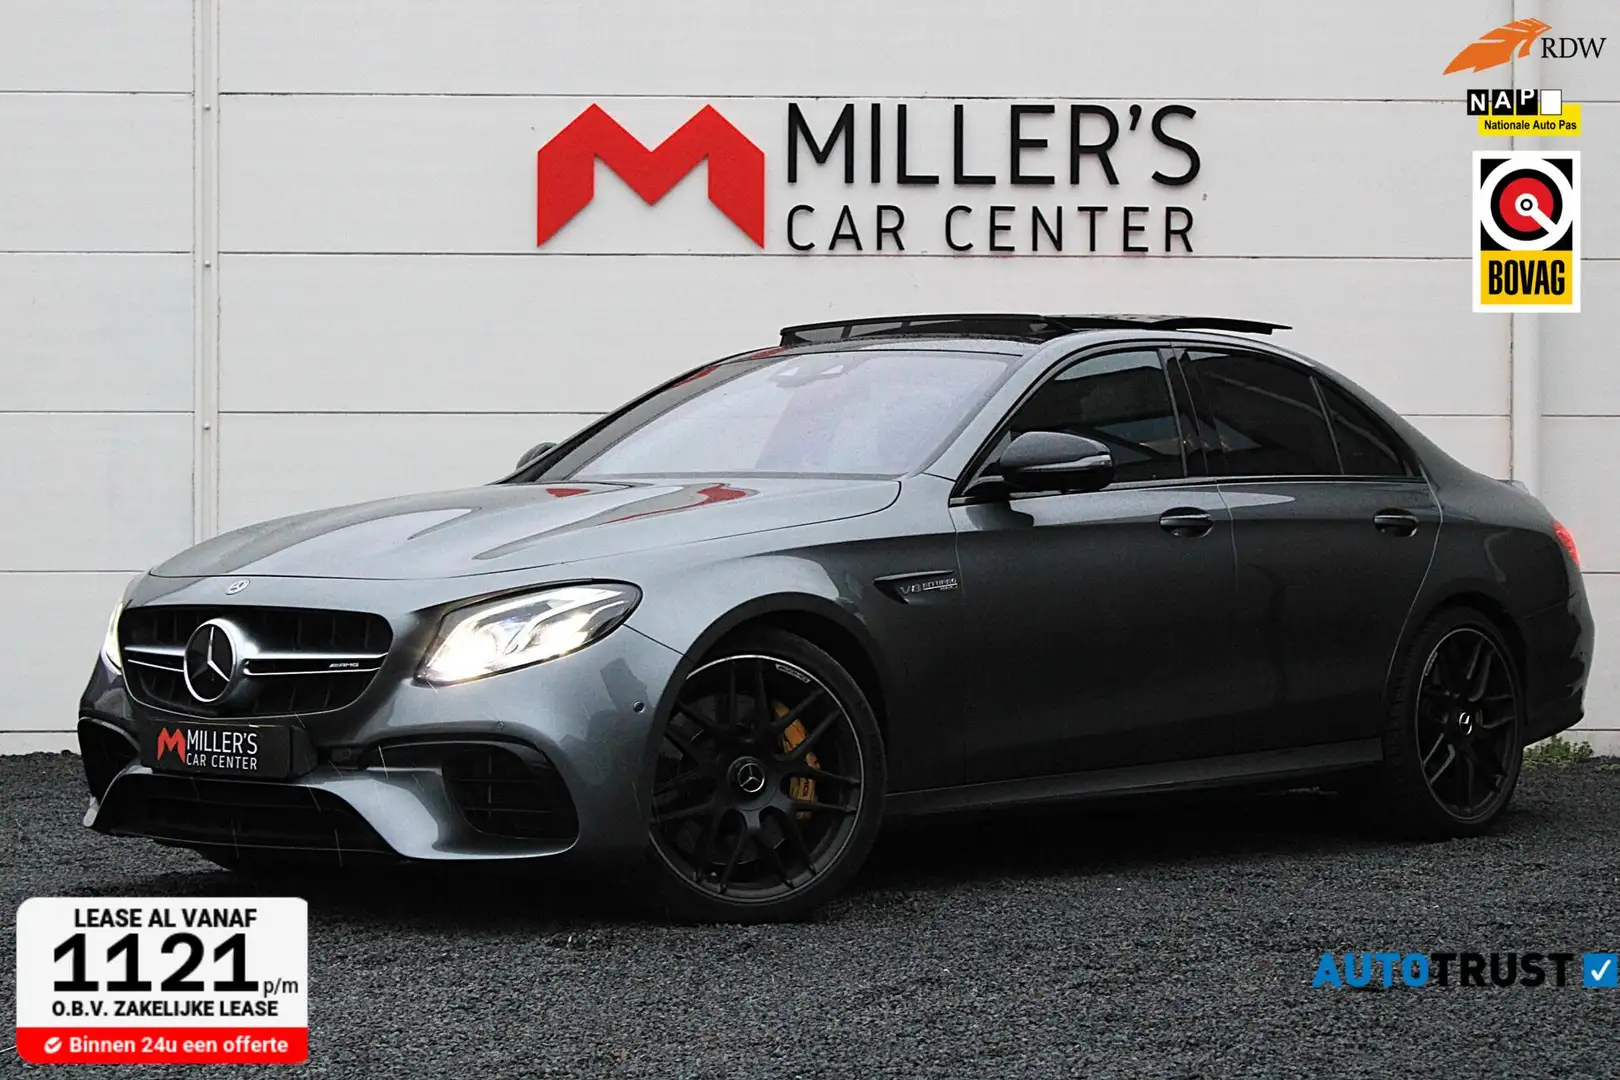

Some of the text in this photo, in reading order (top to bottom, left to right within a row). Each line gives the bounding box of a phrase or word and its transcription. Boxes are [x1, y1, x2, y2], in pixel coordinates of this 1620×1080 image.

[787, 205, 1194, 253] CAR CENTER
[186, 753, 258, 770] CAR CENTER
